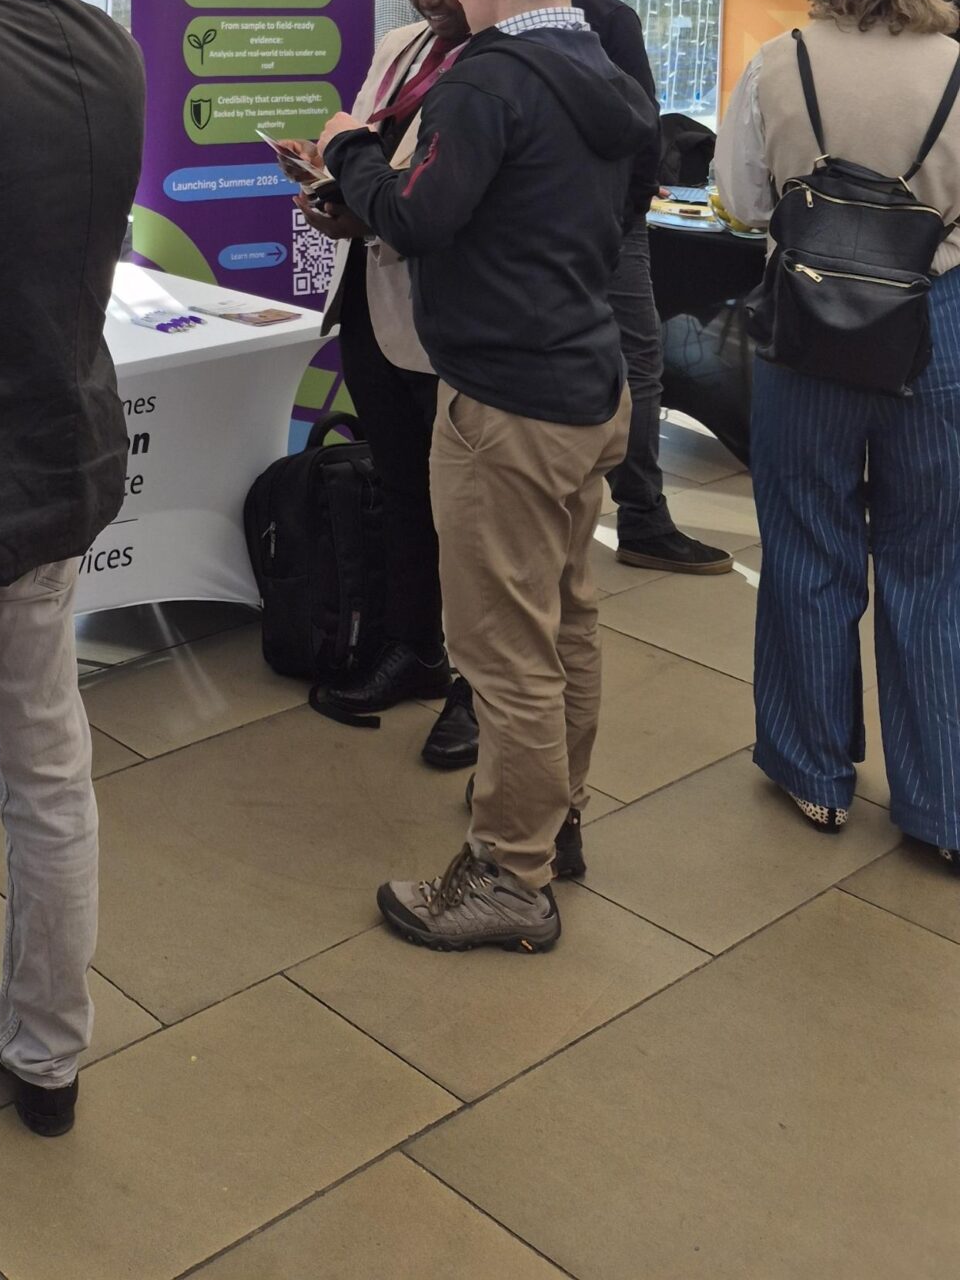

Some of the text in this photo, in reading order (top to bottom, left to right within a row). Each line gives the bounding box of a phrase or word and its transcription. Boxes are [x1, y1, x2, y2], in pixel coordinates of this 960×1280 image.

[221, 21, 239, 30] From
[241, 22, 265, 31] sample
[276, 21, 314, 31] field-ready
[250, 36, 283, 44] evidence:
[209, 50, 233, 58] Analysis
[218, 94, 322, 105] Credibility that carries weight:
[214, 110, 234, 118] Backed
[236, 110, 244, 118] by
[257, 121, 285, 129] authority
[173, 180, 216, 191] Launching
[219, 179, 254, 188] Summer
[257, 175, 278, 185] 2026
